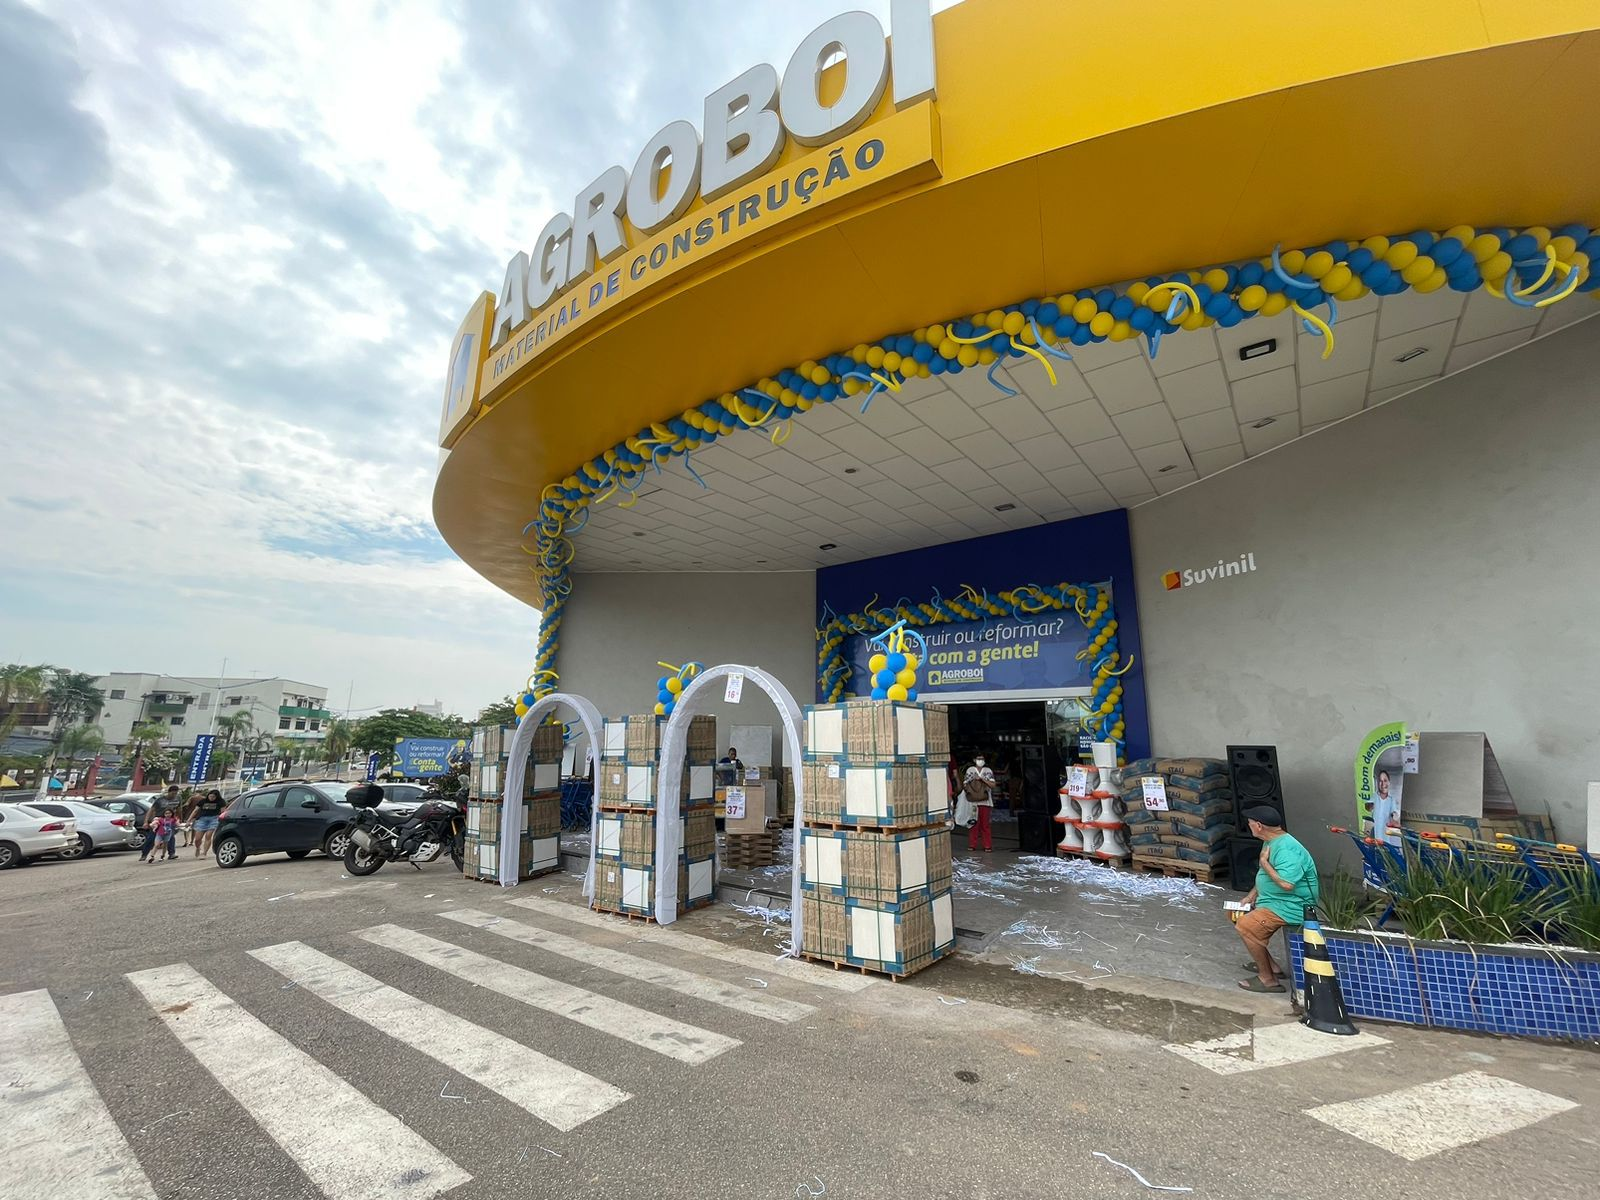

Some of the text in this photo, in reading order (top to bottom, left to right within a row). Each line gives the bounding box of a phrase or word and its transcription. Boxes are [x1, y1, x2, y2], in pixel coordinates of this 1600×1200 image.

[490, 0, 936, 350] AGROBOI
[493, 138, 885, 380] MATERIAL DE CONSTRUÇÃO
[1183, 552, 1257, 587] Suvinil
[954, 631, 975, 644] ou
[979, 617, 1064, 644] reformar?
[929, 650, 963, 666] com
[966, 649, 977, 663] a
[980, 640, 1039, 667] gente!
[942, 668, 984, 679] AGROBOI
[190, 736, 206, 780] ENTRADA
[1362, 731, 1402, 765] demaaais!
[1361, 766, 1371, 791] bom
[727, 805, 738, 815] 37
[1146, 797, 1158, 807] 54
